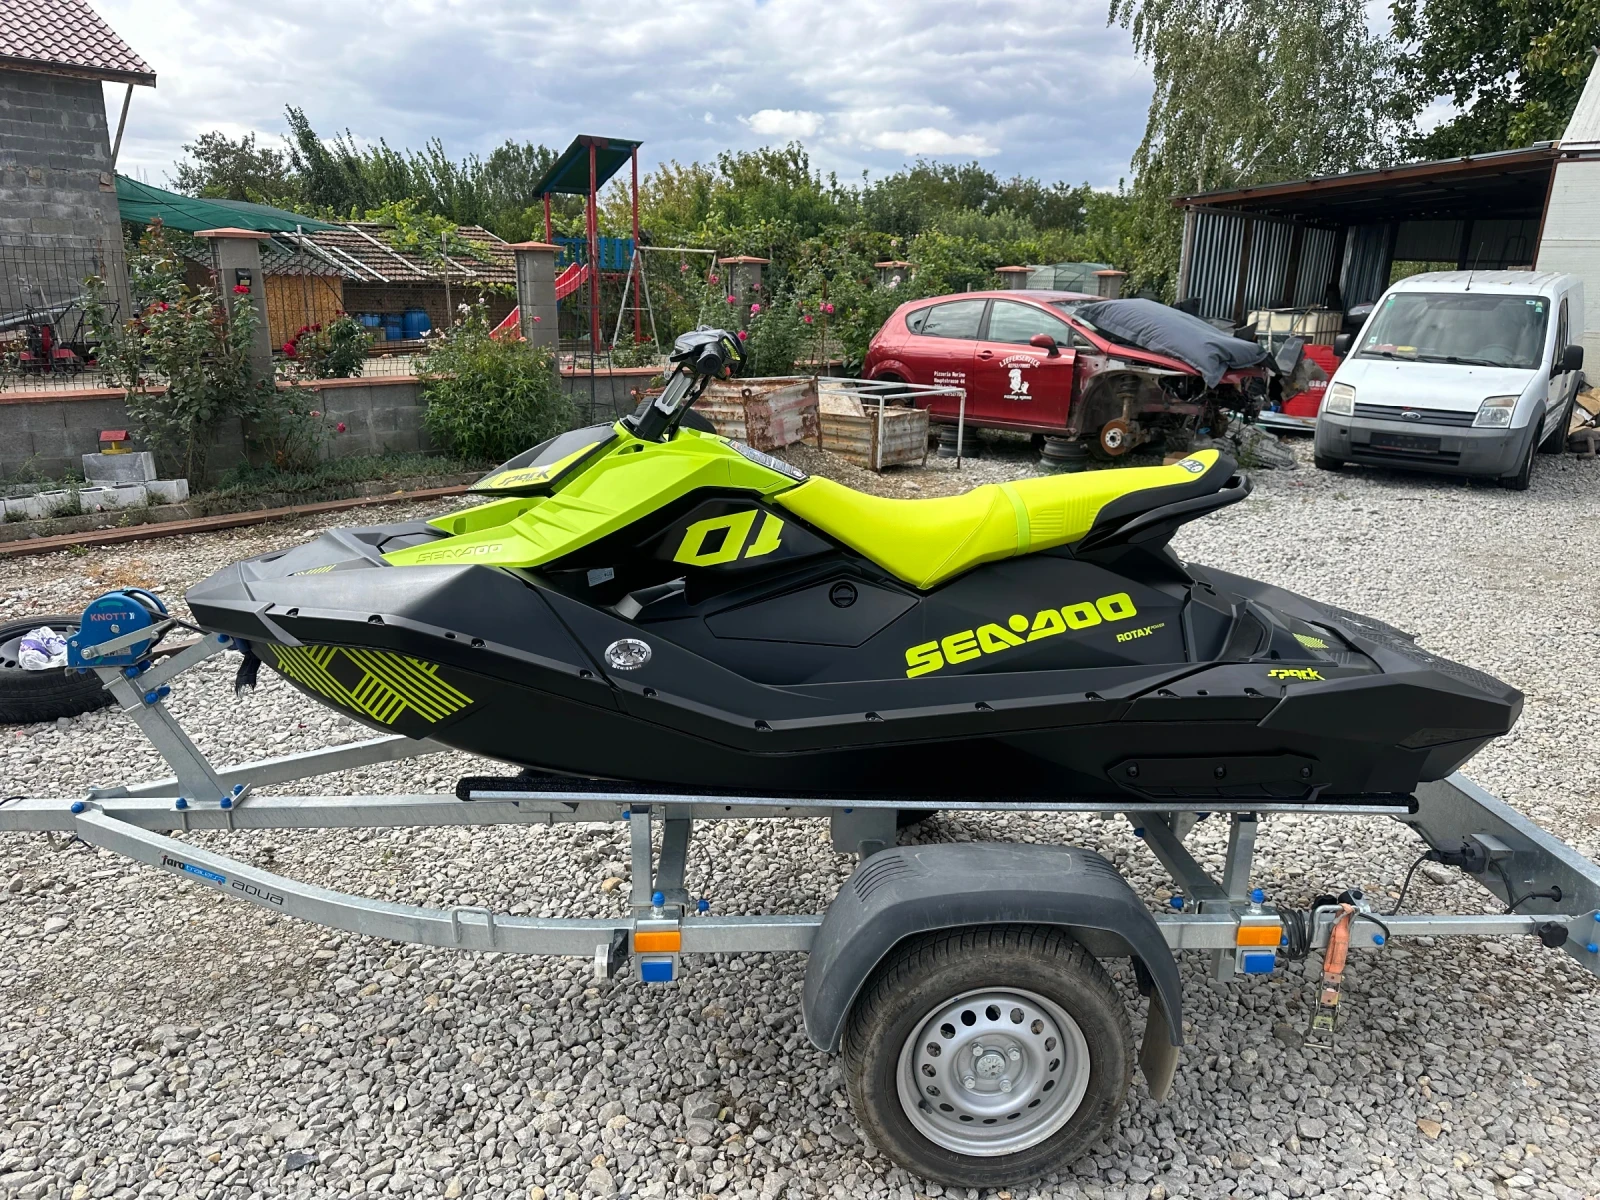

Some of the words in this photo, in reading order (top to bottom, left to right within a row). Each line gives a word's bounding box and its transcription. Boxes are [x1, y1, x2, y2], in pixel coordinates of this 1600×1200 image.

[999, 355, 1041, 368] LIEFERSERVICE
[90, 612, 128, 621] KNOTT
[1116, 626, 1153, 643] ROTAX
[231, 879, 284, 906] aqua
